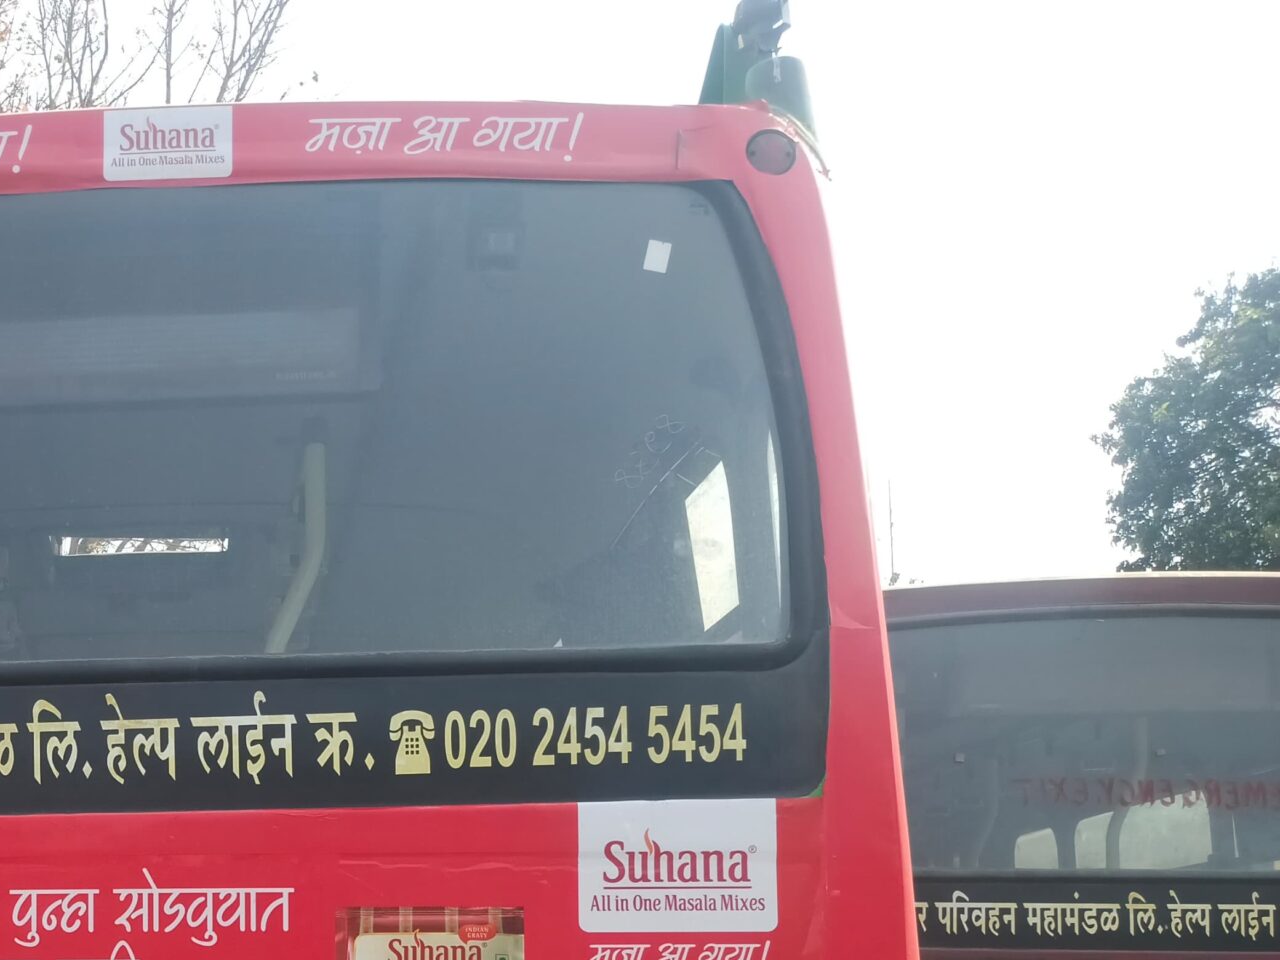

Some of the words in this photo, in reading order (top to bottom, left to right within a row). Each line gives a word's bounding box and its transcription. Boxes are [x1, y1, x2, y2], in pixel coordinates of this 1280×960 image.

[404, 115, 471, 155] आ
[111, 154, 125, 167] All
[127, 155, 135, 166] in
[137, 154, 157, 166] One
[158, 153, 193, 166] Masala
[194, 153, 225, 165] Mixes
[27, 699, 92, 786] लि.
[100, 693, 180, 783] हेल्प
[190, 690, 297, 785] लाईन
[306, 711, 375, 782] क्र.
[444, 707, 517, 769] 020
[532, 704, 632, 768] 2454
[647, 702, 747, 764] 5454
[9, 888, 99, 947] पुन्हा
[590, 894, 614, 912] All
[616, 895, 630, 912] in
[633, 896, 661, 912] One
[664, 894, 718, 912] Masala
[720, 893, 766, 912] Mixes
[934, 890, 1018, 936] परिवहन
[1023, 891, 1121, 937] महामंडळ
[1166, 889, 1212, 938] हेल्प
[1217, 891, 1277, 941] लाईन
